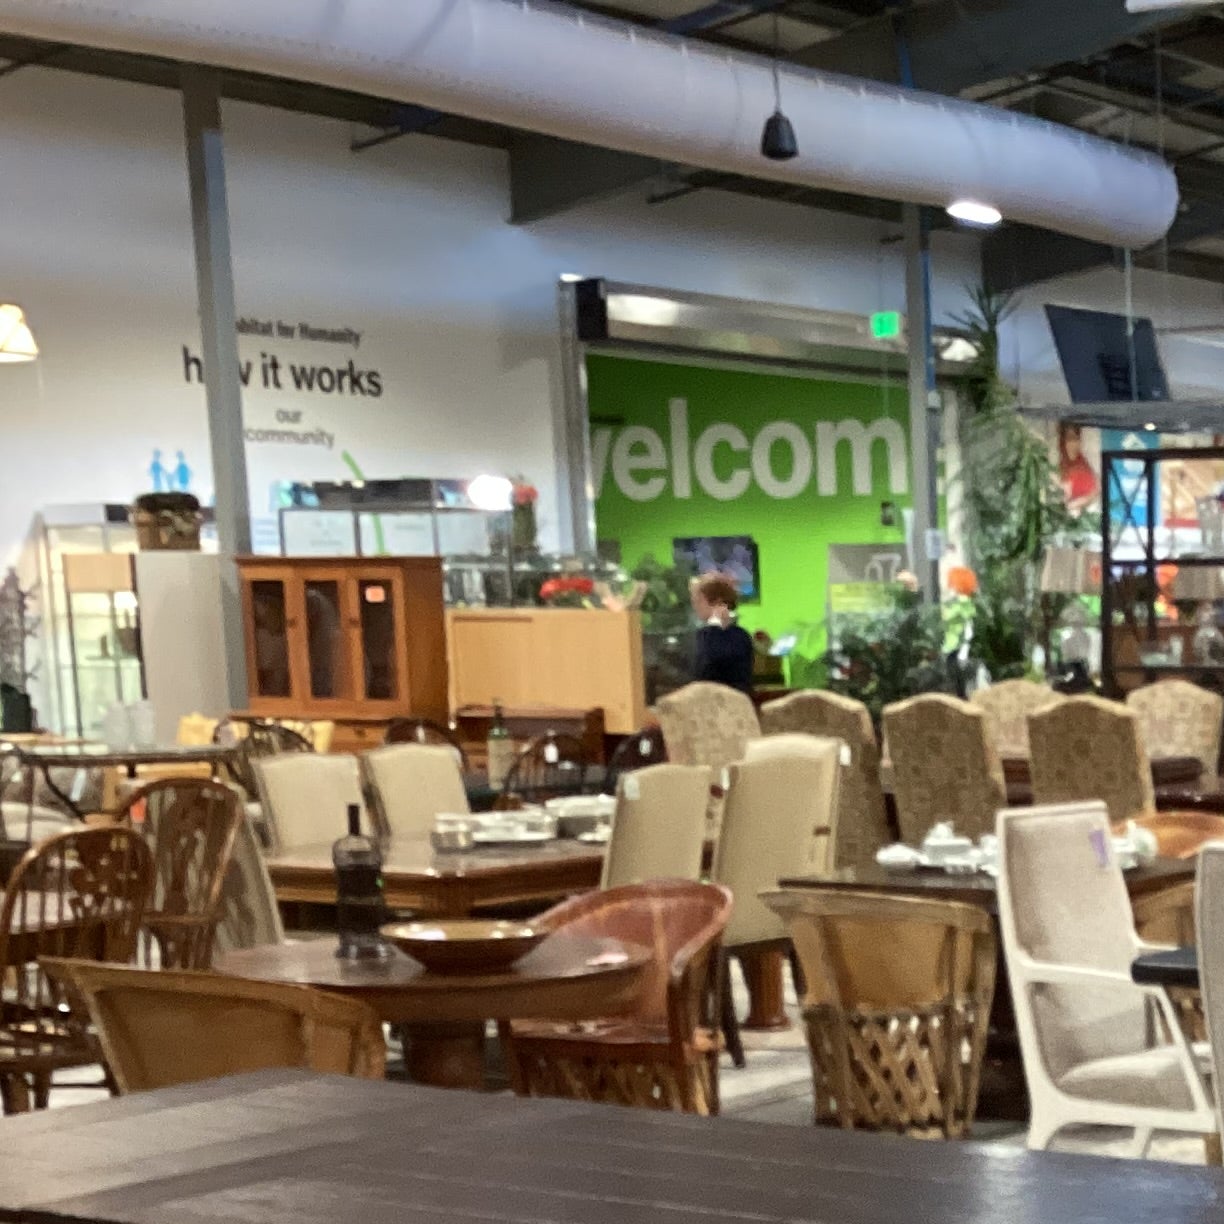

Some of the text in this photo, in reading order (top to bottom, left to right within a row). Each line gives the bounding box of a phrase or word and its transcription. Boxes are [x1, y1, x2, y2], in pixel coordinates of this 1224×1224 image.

[298, 322, 362, 349] Humanity
[183, 343, 384, 398] hw it works
[275, 408, 302, 424] our
[244, 428, 335, 449] community
[590, 398, 946, 501] elcom
